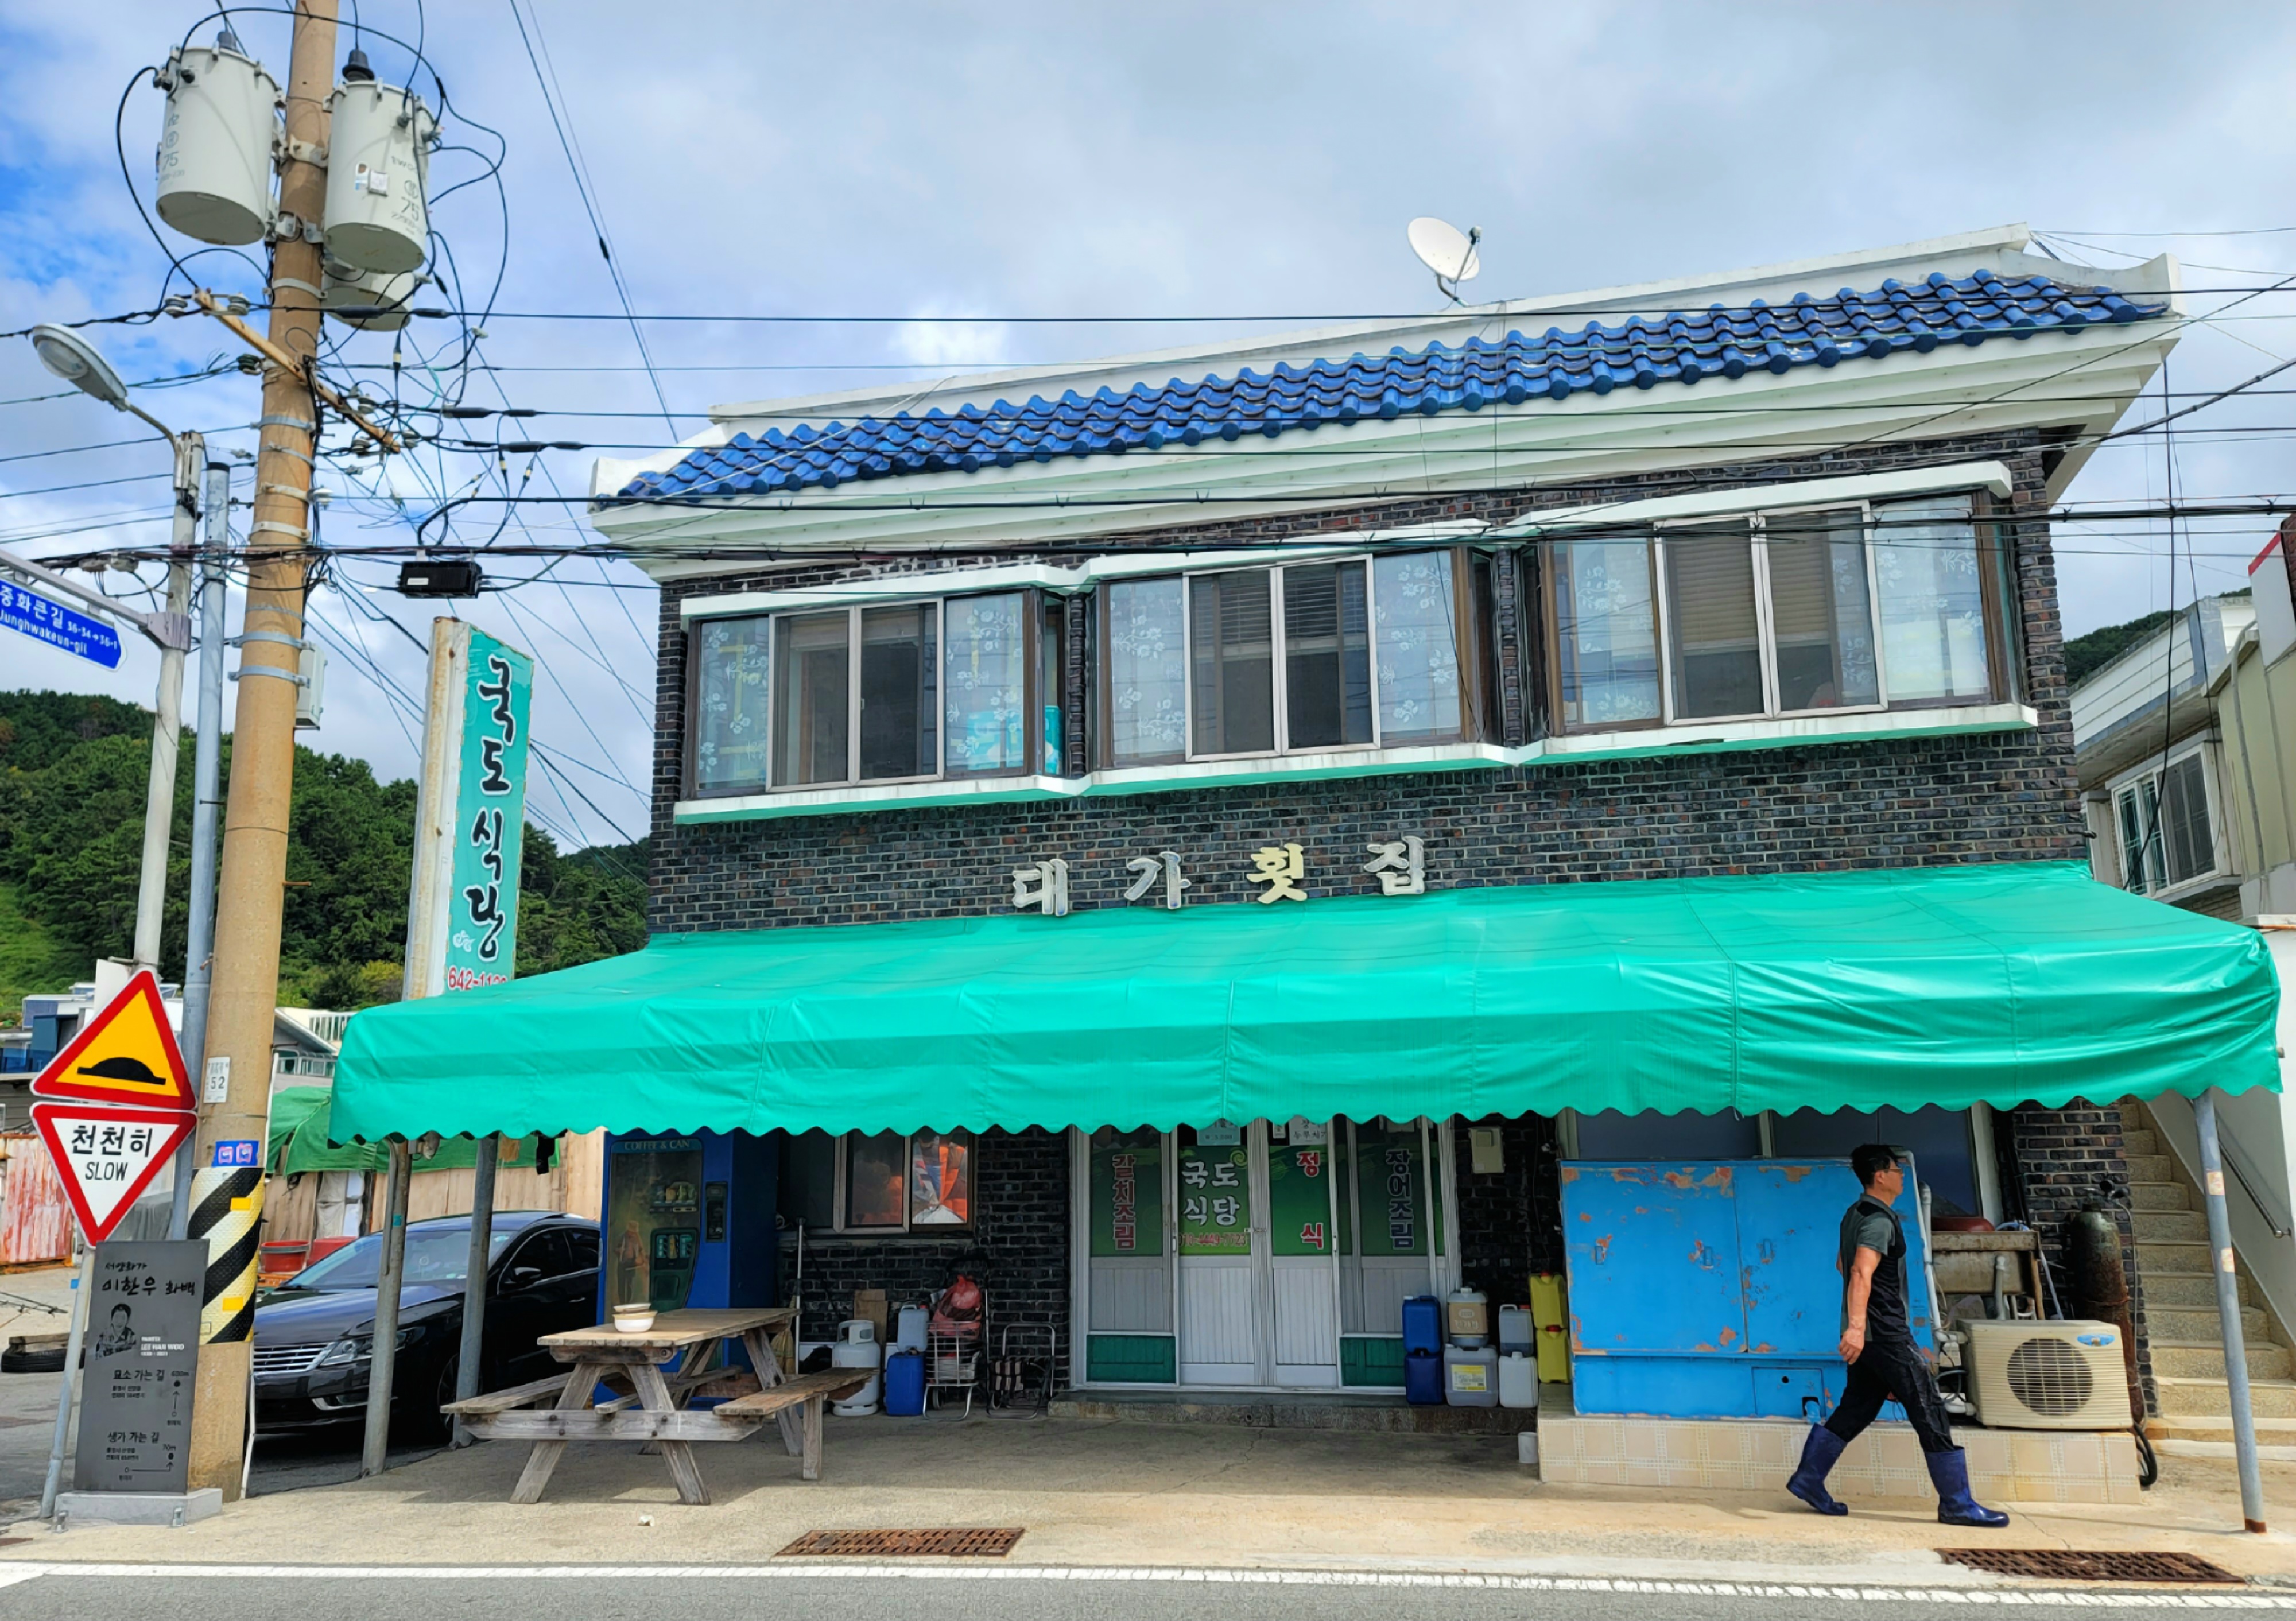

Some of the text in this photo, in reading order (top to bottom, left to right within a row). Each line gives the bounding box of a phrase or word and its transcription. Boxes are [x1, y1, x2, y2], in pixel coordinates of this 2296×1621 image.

[0, 584, 64, 630] 중화큰길
[0, 609, 88, 655] Junghwakeun-gil
[463, 654, 515, 962] 국도식당
[71, 1125, 153, 1157] 천천히
[669, 1139, 689, 1149] CAN
[84, 1161, 129, 1181] SLOW
[1181, 1161, 1240, 1189] 국도
[1112, 1154, 1136, 1250] 갈치조림
[1182, 1195, 1240, 1226] 식당
[1385, 1149, 1414, 1250] 장어조림
[102, 1276, 196, 1296] 이한우 화백
[134, 1369, 153, 1381] 가는
[156, 1369, 165, 1381] 길
[107, 1432, 160, 1444] 생가 가는 길
